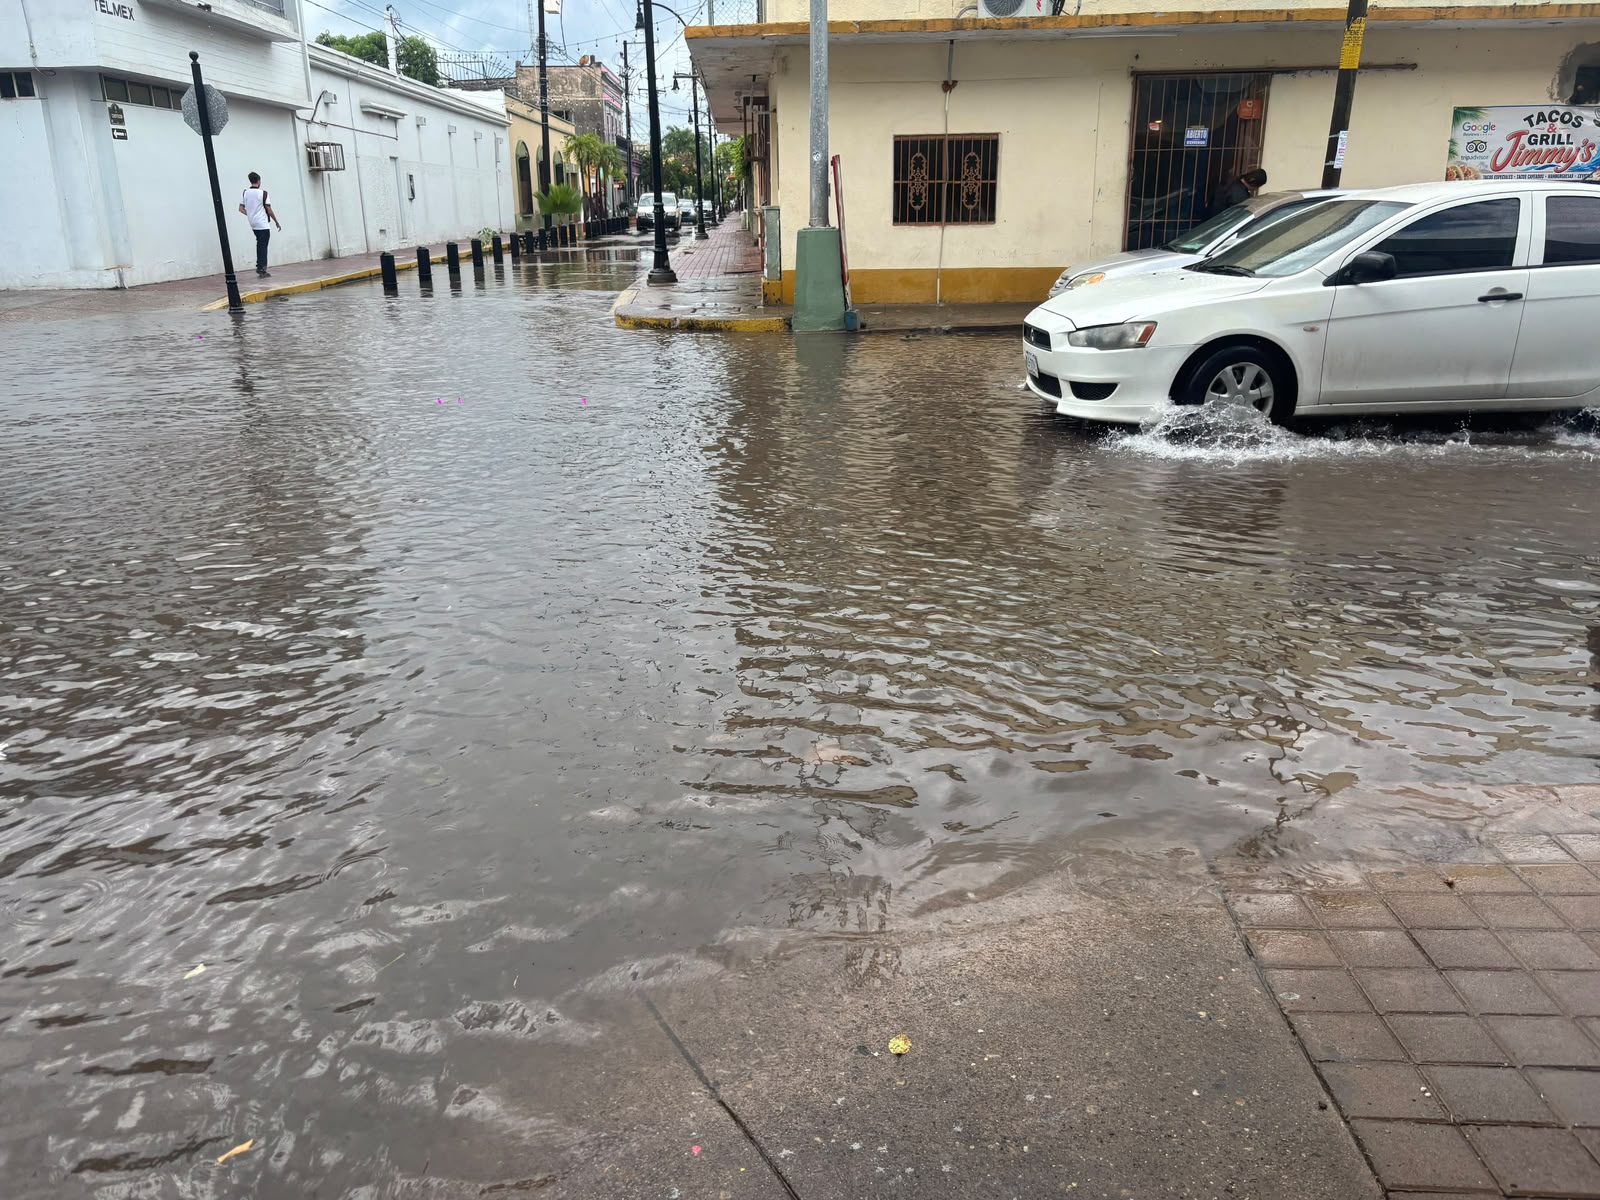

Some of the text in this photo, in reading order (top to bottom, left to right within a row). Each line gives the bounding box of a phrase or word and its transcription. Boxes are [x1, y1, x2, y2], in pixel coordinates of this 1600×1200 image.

[94, 0, 135, 21] TELMEX
[1462, 121, 1496, 133] Google
[1523, 109, 1584, 129] TACOS
[1547, 122, 1557, 134] &
[1527, 133, 1574, 146] GRILL
[1490, 130, 1596, 173] Jimmy's
